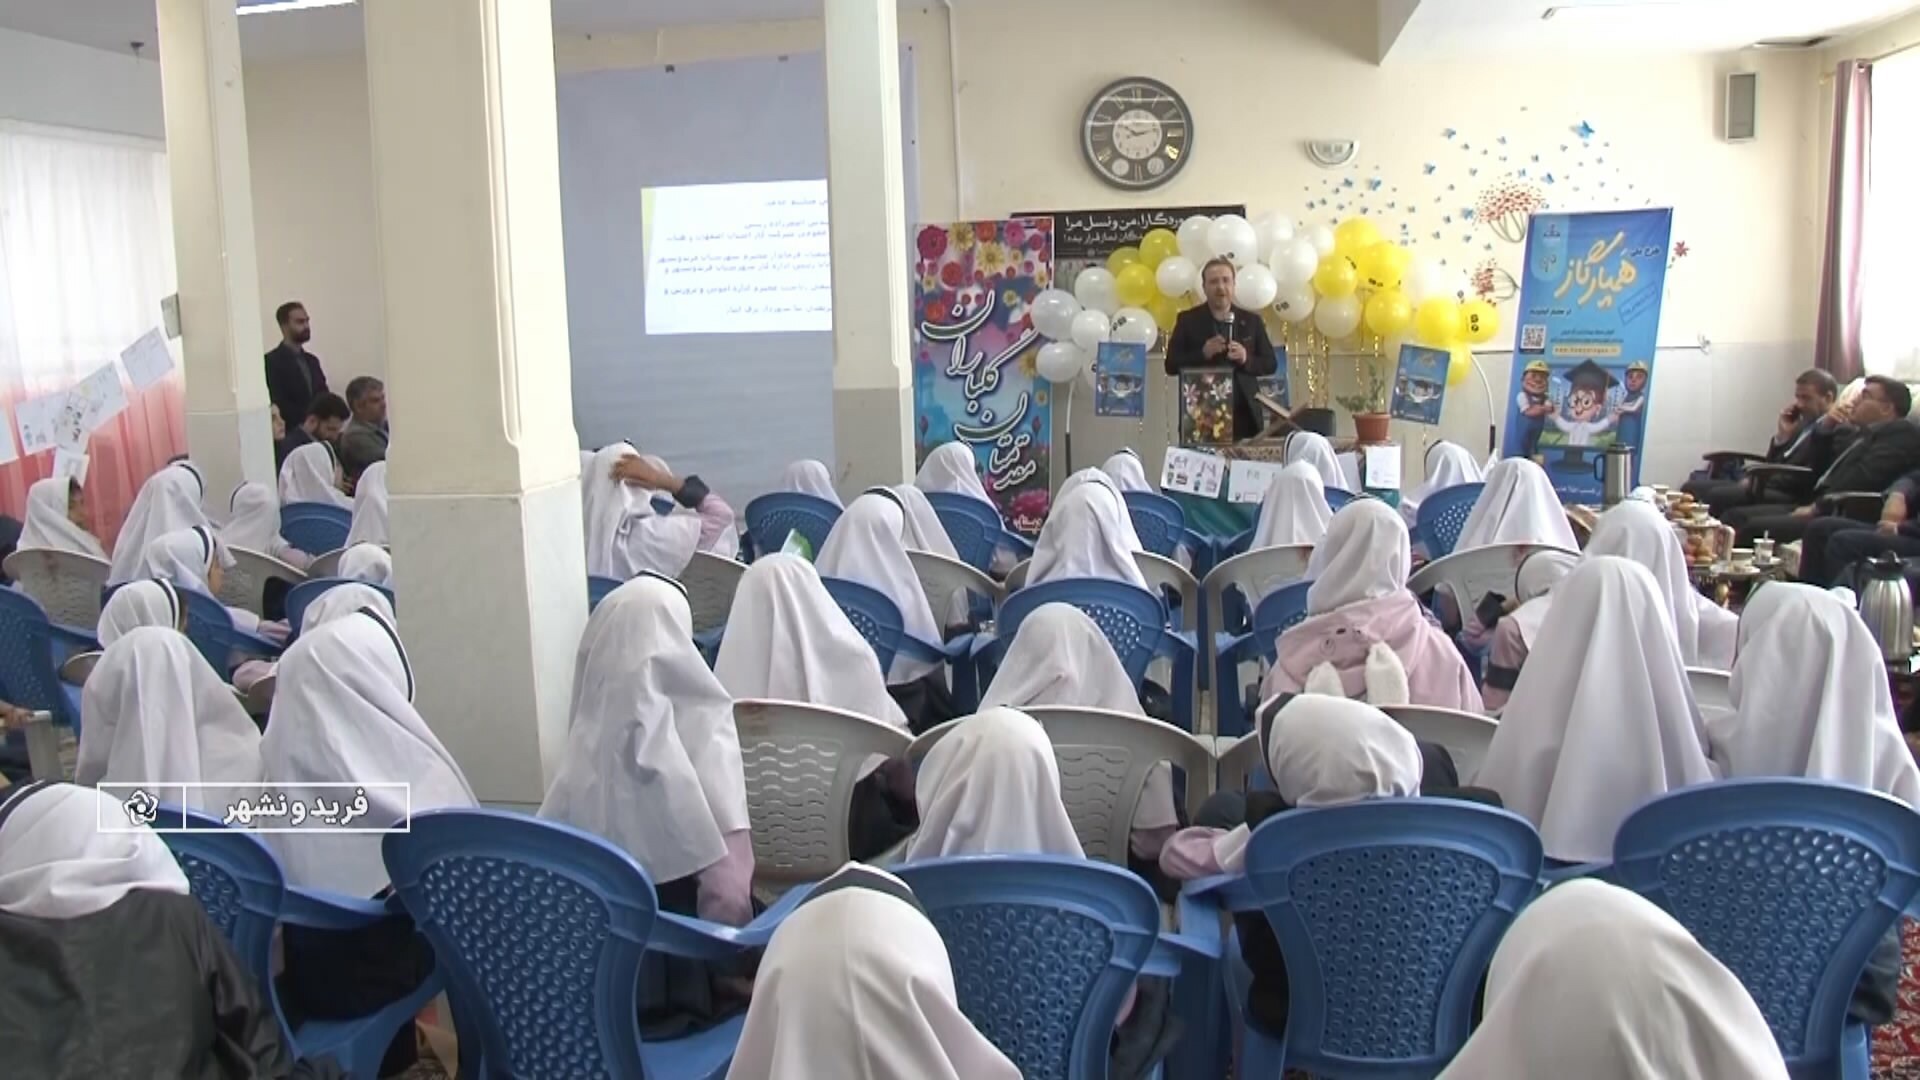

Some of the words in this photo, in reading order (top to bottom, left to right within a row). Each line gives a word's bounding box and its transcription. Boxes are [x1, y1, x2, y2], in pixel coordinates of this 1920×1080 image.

[1064, 215, 1083, 231] مرا
[1119, 218, 1137, 231] من
[1083, 231, 1100, 245] قرار
[1554, 230, 1625, 298] گاز
[1577, 257, 1638, 309] همیار
